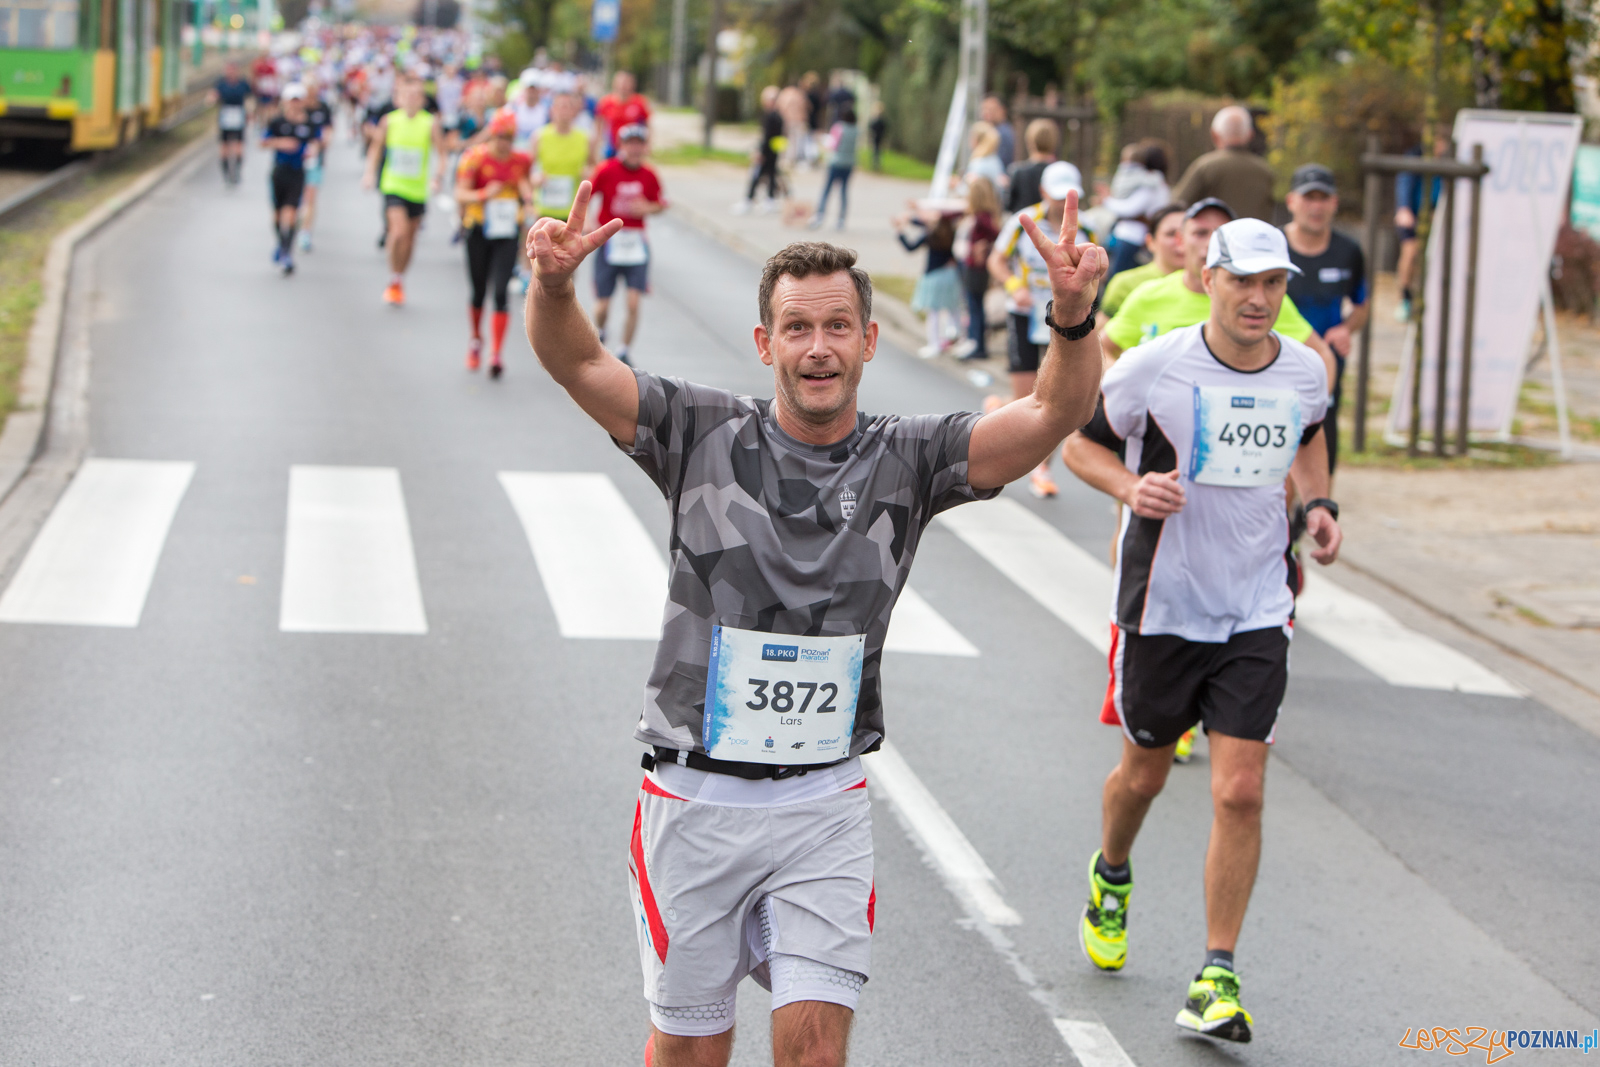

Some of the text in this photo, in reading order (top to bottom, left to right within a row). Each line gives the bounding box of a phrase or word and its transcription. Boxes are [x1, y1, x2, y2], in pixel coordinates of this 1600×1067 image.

[1219, 423, 1286, 448] 4903
[766, 649, 795, 658] 18. PKO
[746, 678, 838, 713] 3872
[780, 715, 803, 726] Lars
